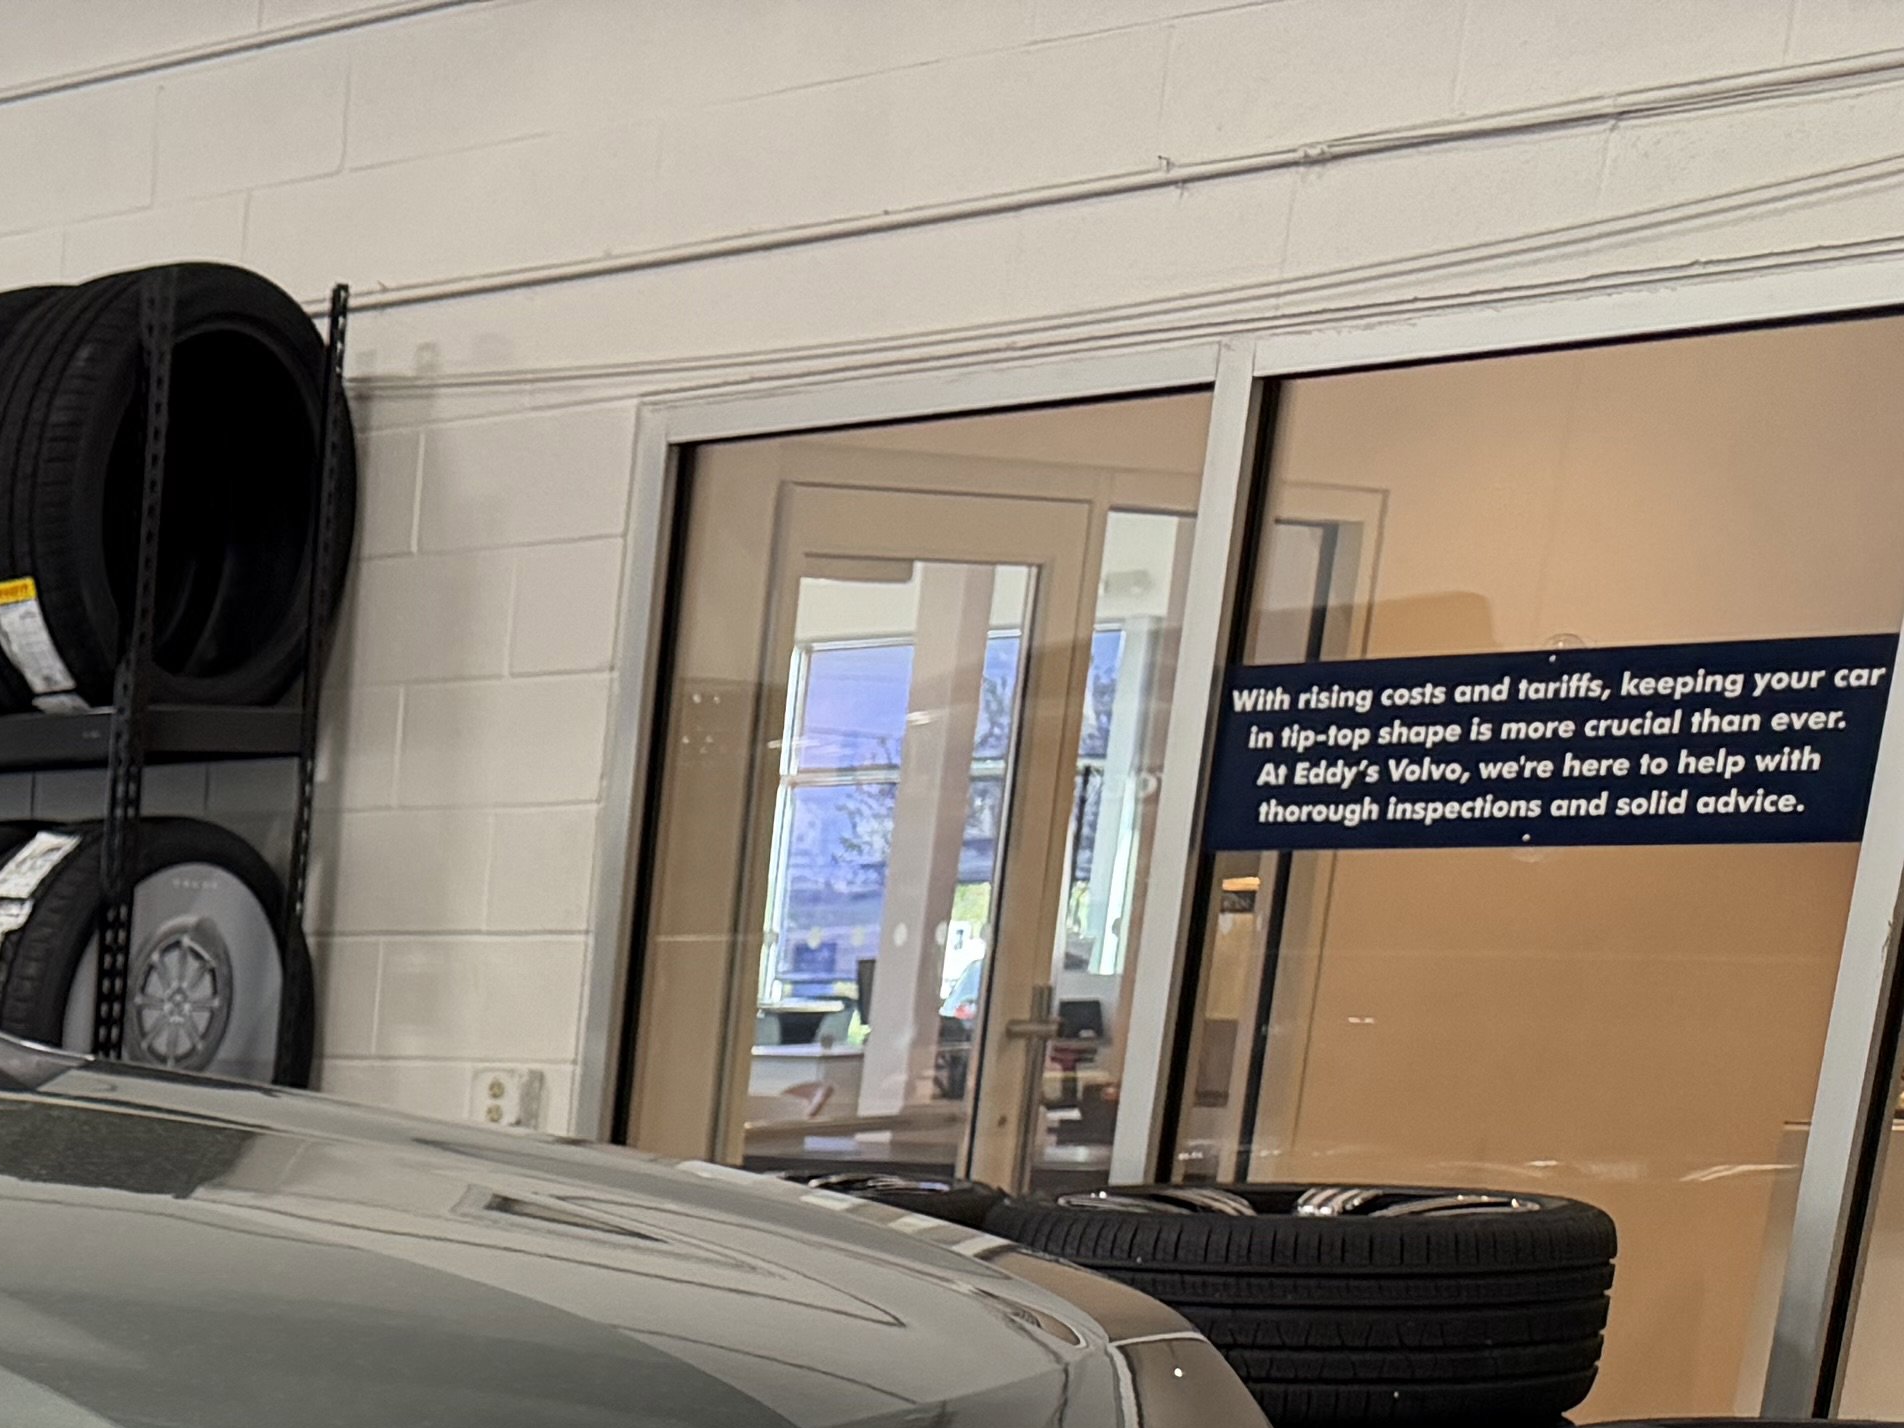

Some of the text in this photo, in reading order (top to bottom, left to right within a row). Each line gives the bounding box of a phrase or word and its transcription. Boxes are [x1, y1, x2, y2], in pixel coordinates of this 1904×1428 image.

[1232, 667, 1887, 713] With rising costs and tariffs, keeping your car
[1247, 707, 1847, 753] in tip-top shape is more crucial than ever.
[1255, 745, 1823, 789] At Eddy’s Volvo, we're here to help with
[1258, 787, 1805, 828] thorough inspections and solid advice.
